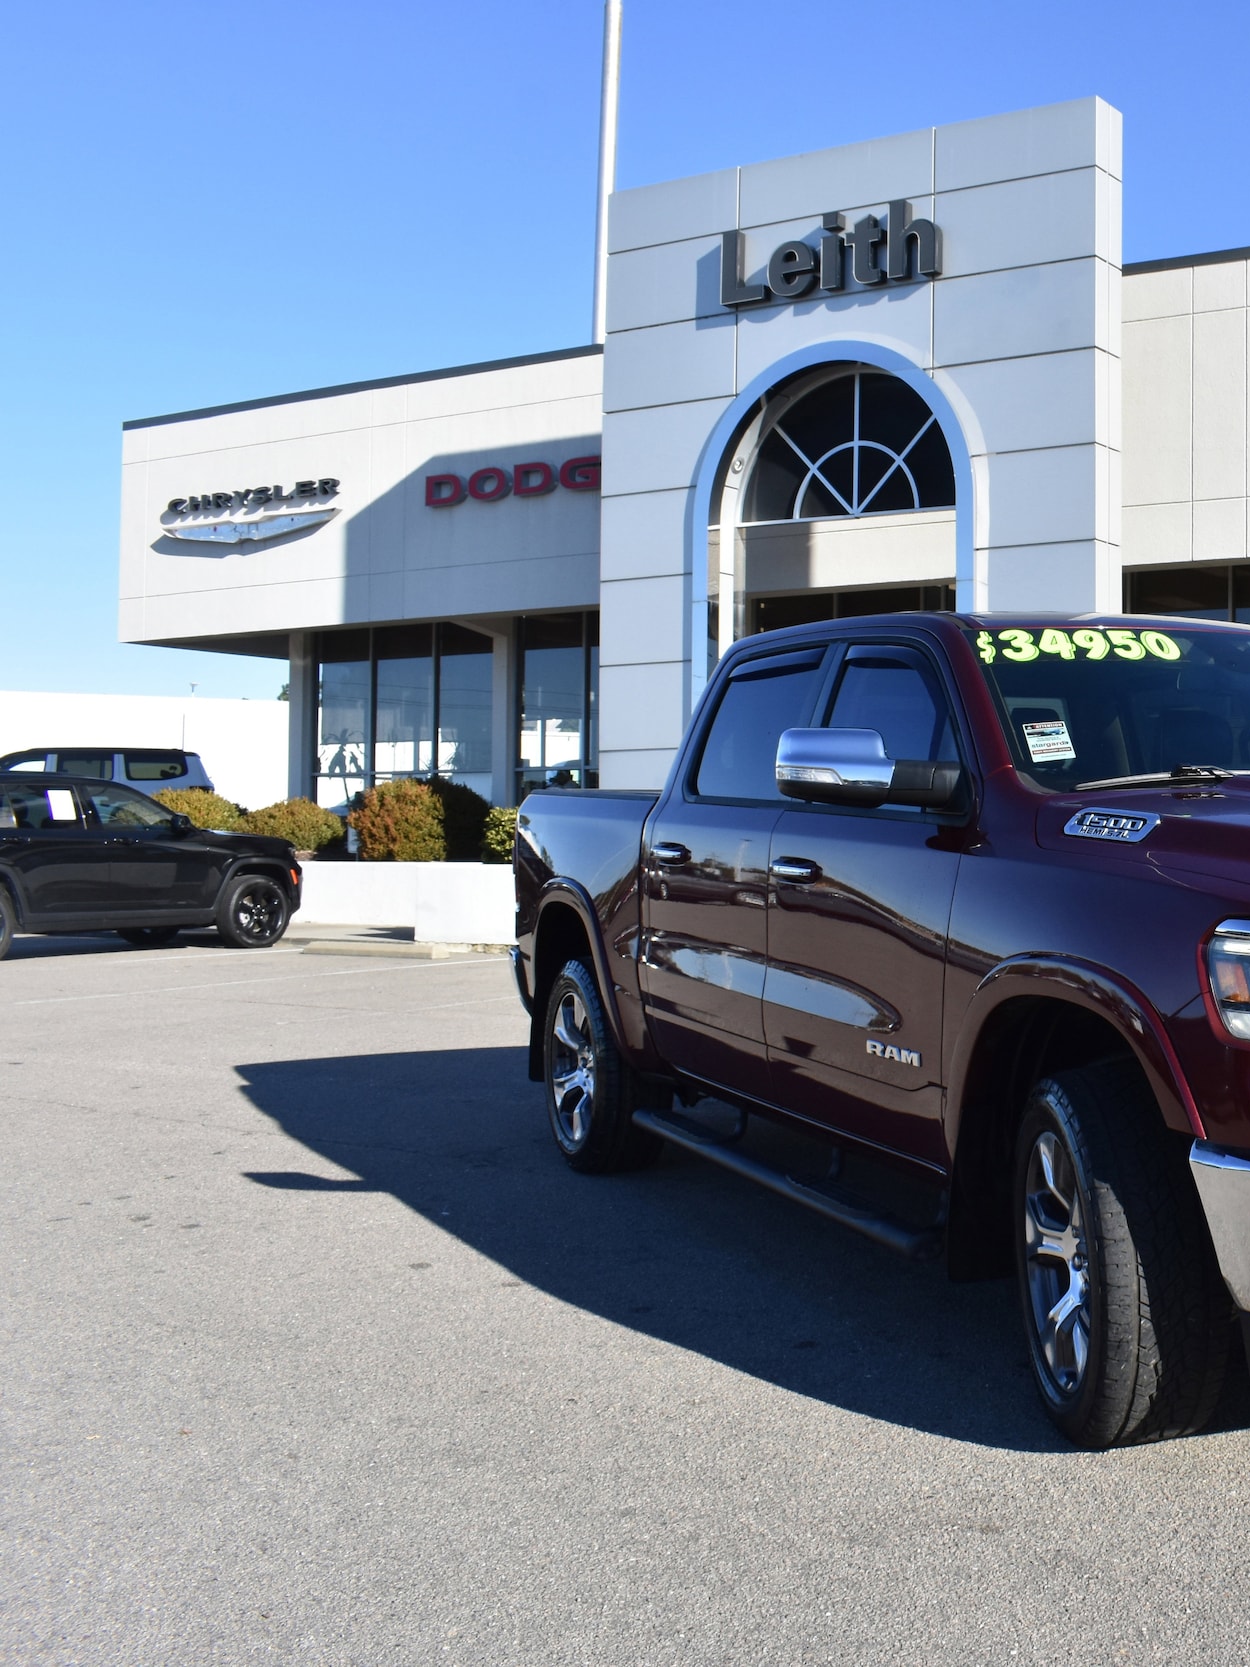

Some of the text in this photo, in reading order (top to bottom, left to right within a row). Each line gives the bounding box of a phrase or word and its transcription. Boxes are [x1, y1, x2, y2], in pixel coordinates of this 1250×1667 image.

[720, 199, 943, 308] Leith
[167, 477, 341, 514] CHRYSLER
[425, 455, 601, 508] DODG
[976, 628, 1182, 665] $34950
[1082, 814, 1144, 831] 1500
[866, 1039, 921, 1067] RAM
